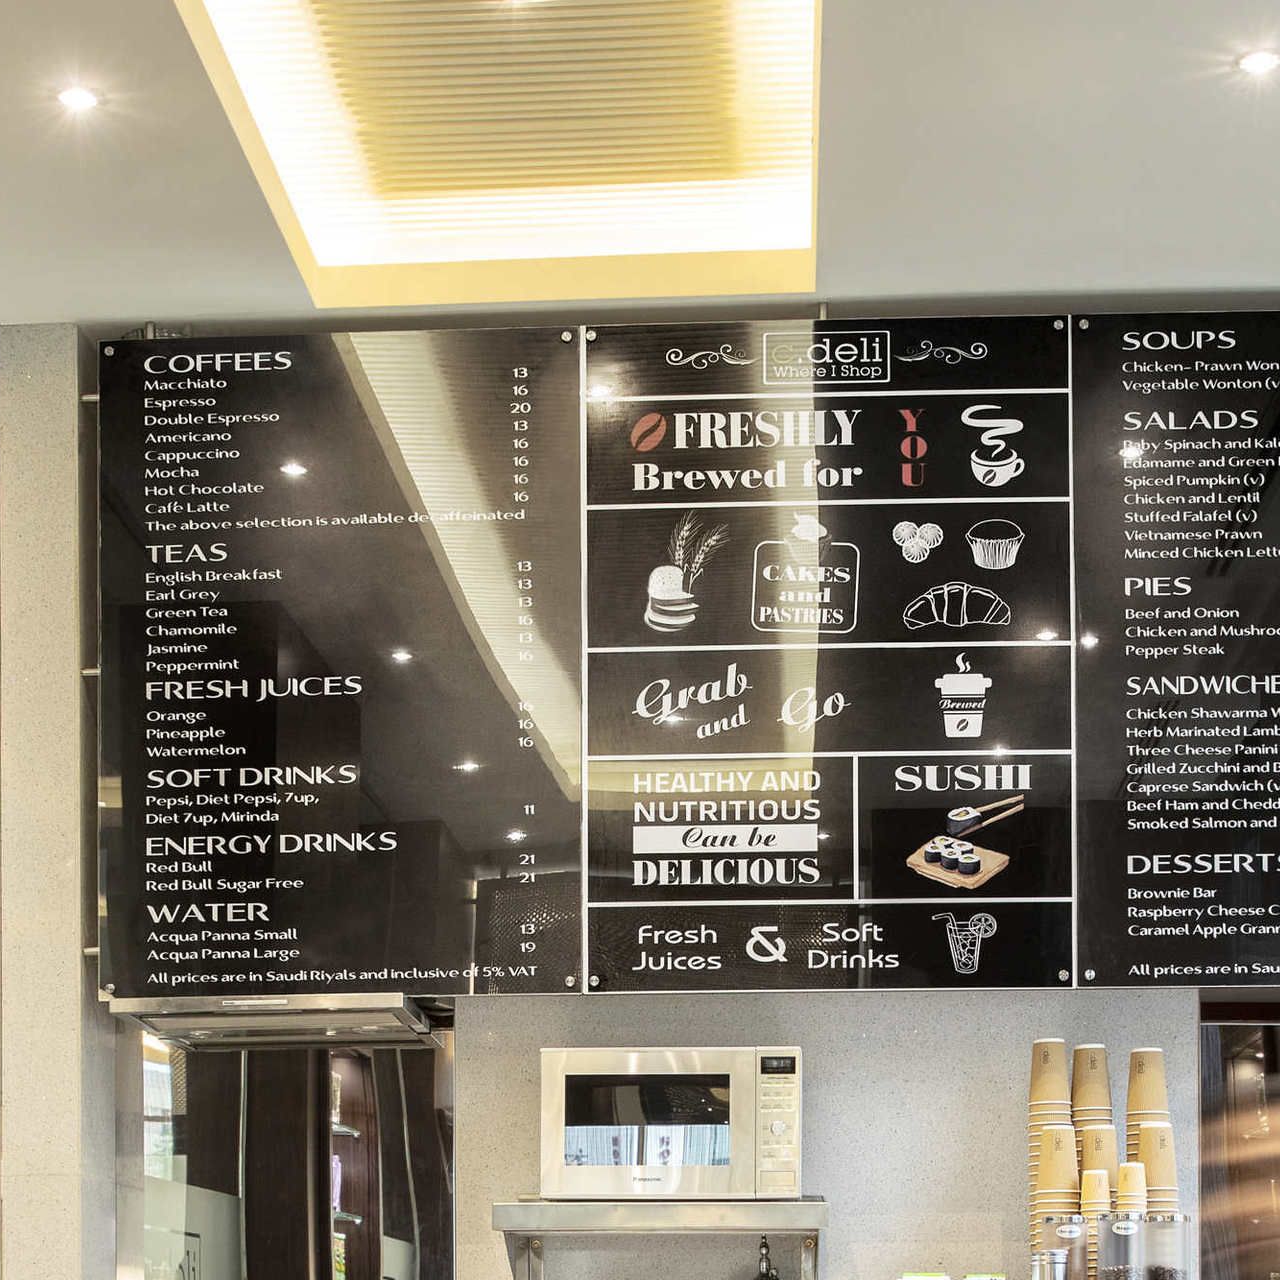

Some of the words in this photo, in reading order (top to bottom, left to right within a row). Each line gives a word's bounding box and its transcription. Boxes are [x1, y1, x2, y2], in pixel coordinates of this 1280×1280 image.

[1123, 331, 1235, 350] SOUPS
[144, 352, 291, 373] COFFEES
[773, 365, 827, 378] Where
[830, 365, 837, 377] I
[840, 363, 882, 379] Shop
[1195, 361, 1242, 371] Prawn
[513, 368, 528, 378] 13
[145, 378, 227, 390] Macchiato
[513, 385, 528, 396] 16
[145, 398, 216, 411] Espresso
[511, 403, 531, 413] 20
[145, 413, 204, 425] Double
[208, 413, 279, 426] Espresso
[1124, 410, 1258, 430] SALADS
[673, 410, 862, 448] FRESHLY
[145, 449, 240, 463] Cappuccino
[896, 408, 929, 488] YOU
[630, 459, 786, 491] Brewed
[803, 458, 863, 488] for
[1125, 474, 1173, 490] Spiced
[1177, 474, 1240, 488] Pumpkin
[1244, 473, 1264, 486] (v)
[145, 486, 174, 496] Hot
[179, 483, 264, 495] Chocolate
[1124, 493, 1185, 504] Chicken
[1188, 492, 1215, 503] and
[1219, 492, 1260, 503] Lentil
[145, 501, 183, 513] Café
[187, 502, 229, 512] Latte
[146, 521, 176, 531] The
[180, 520, 232, 530] above
[236, 517, 312, 528] selection
[316, 516, 328, 525] is
[331, 513, 404, 525] available
[146, 543, 227, 563] TEAS
[517, 561, 532, 571] 13
[762, 564, 852, 583] CAKES
[146, 571, 202, 586] English
[206, 569, 281, 581] Breakfast
[778, 586, 831, 604] and
[1125, 577, 1191, 596] PIES
[759, 606, 844, 625] PASTRIES
[1126, 608, 1160, 619] Beef
[1164, 607, 1190, 618] and
[1194, 608, 1239, 618] Onion
[146, 623, 237, 636] Chamomile
[147, 659, 239, 674] Peppermint
[146, 680, 248, 700] FRESH
[257, 676, 361, 701] JUICES
[632, 662, 753, 731] Grab
[777, 685, 852, 733] Go
[938, 697, 986, 711] Brewed
[147, 711, 206, 724] Orange
[518, 719, 533, 729] 16
[696, 703, 750, 740] and
[147, 727, 225, 741] Pineapple
[1127, 726, 1163, 737] Herb
[1166, 725, 1240, 737] Marinated
[147, 744, 246, 757] Watermelon
[147, 768, 231, 788] SOFT
[240, 765, 356, 786] DRINKS
[633, 770, 753, 794] HEALTHY
[760, 769, 821, 792] AND
[895, 765, 1032, 791] SUSHI
[146, 795, 193, 809] Pepsi,
[197, 794, 229, 805] Diet
[234, 793, 281, 807] Pepsi,
[285, 792, 319, 806] 7up,
[525, 805, 534, 814] 11
[635, 799, 820, 822] NUTRITIOUS
[146, 835, 271, 856] ENERGY
[280, 832, 397, 853] DRINKS
[681, 826, 738, 848] Can
[748, 825, 778, 848] be
[147, 862, 178, 873] Red
[182, 861, 212, 872] Bull
[520, 854, 534, 864] 21
[632, 858, 820, 885] DELICIOUS
[1128, 888, 1190, 899] Brownie
[1193, 888, 1216, 898] Bar
[147, 903, 269, 923] WATER
[1128, 905, 1204, 921] Raspberry
[1207, 905, 1265, 916] Cheese
[147, 932, 198, 945] Acqua
[202, 931, 250, 941] Panna
[254, 928, 297, 940] Small
[520, 924, 537, 934] 13
[822, 919, 883, 942] Soft
[639, 925, 717, 944] Fresh
[746, 926, 788, 962] &
[632, 952, 721, 970] Juices
[808, 949, 899, 968] Drinks
[1129, 964, 1150, 975] All
[1154, 965, 1202, 978] prices
[1206, 966, 1231, 974] are
[1234, 964, 1248, 973] in
